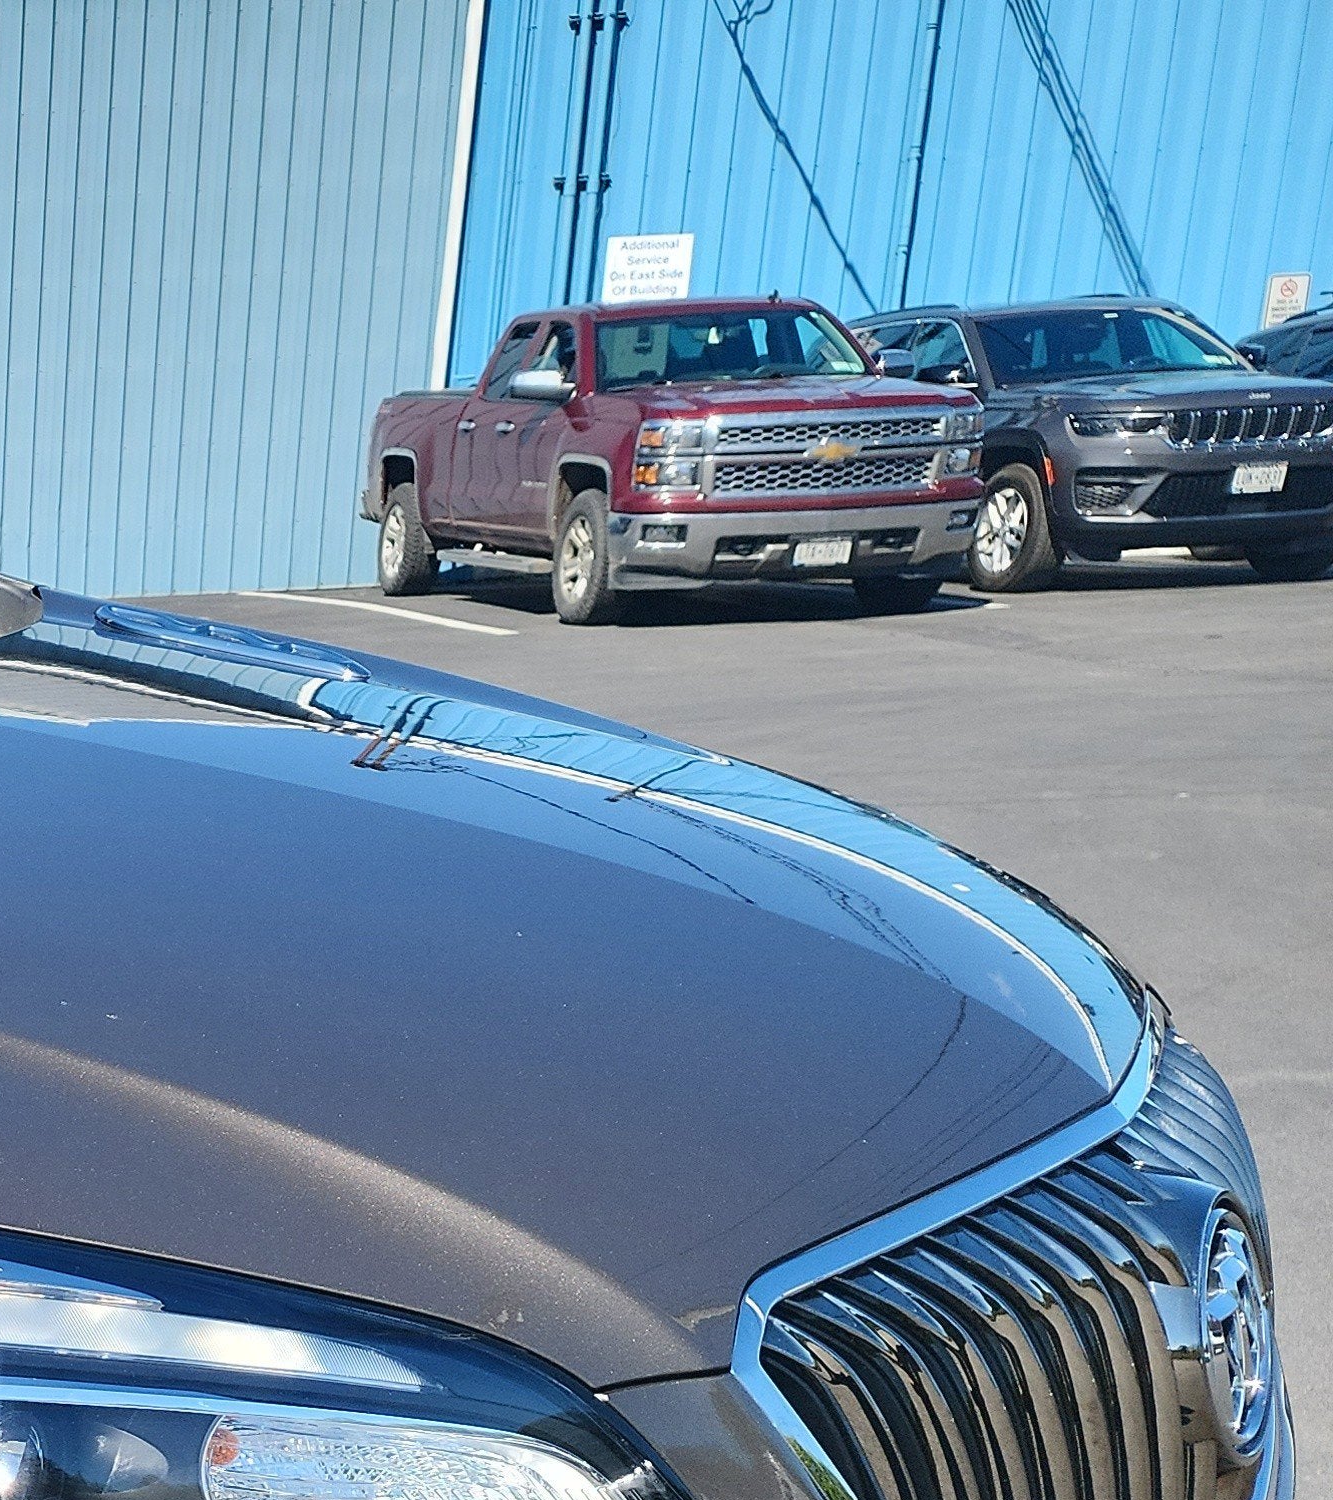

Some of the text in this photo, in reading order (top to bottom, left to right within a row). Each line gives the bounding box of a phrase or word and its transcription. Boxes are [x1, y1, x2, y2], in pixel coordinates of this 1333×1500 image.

[620, 239, 679, 251] Additional
[627, 255, 669, 265] Service
[610, 268, 683, 281] On East Side
[629, 284, 677, 296] Building
